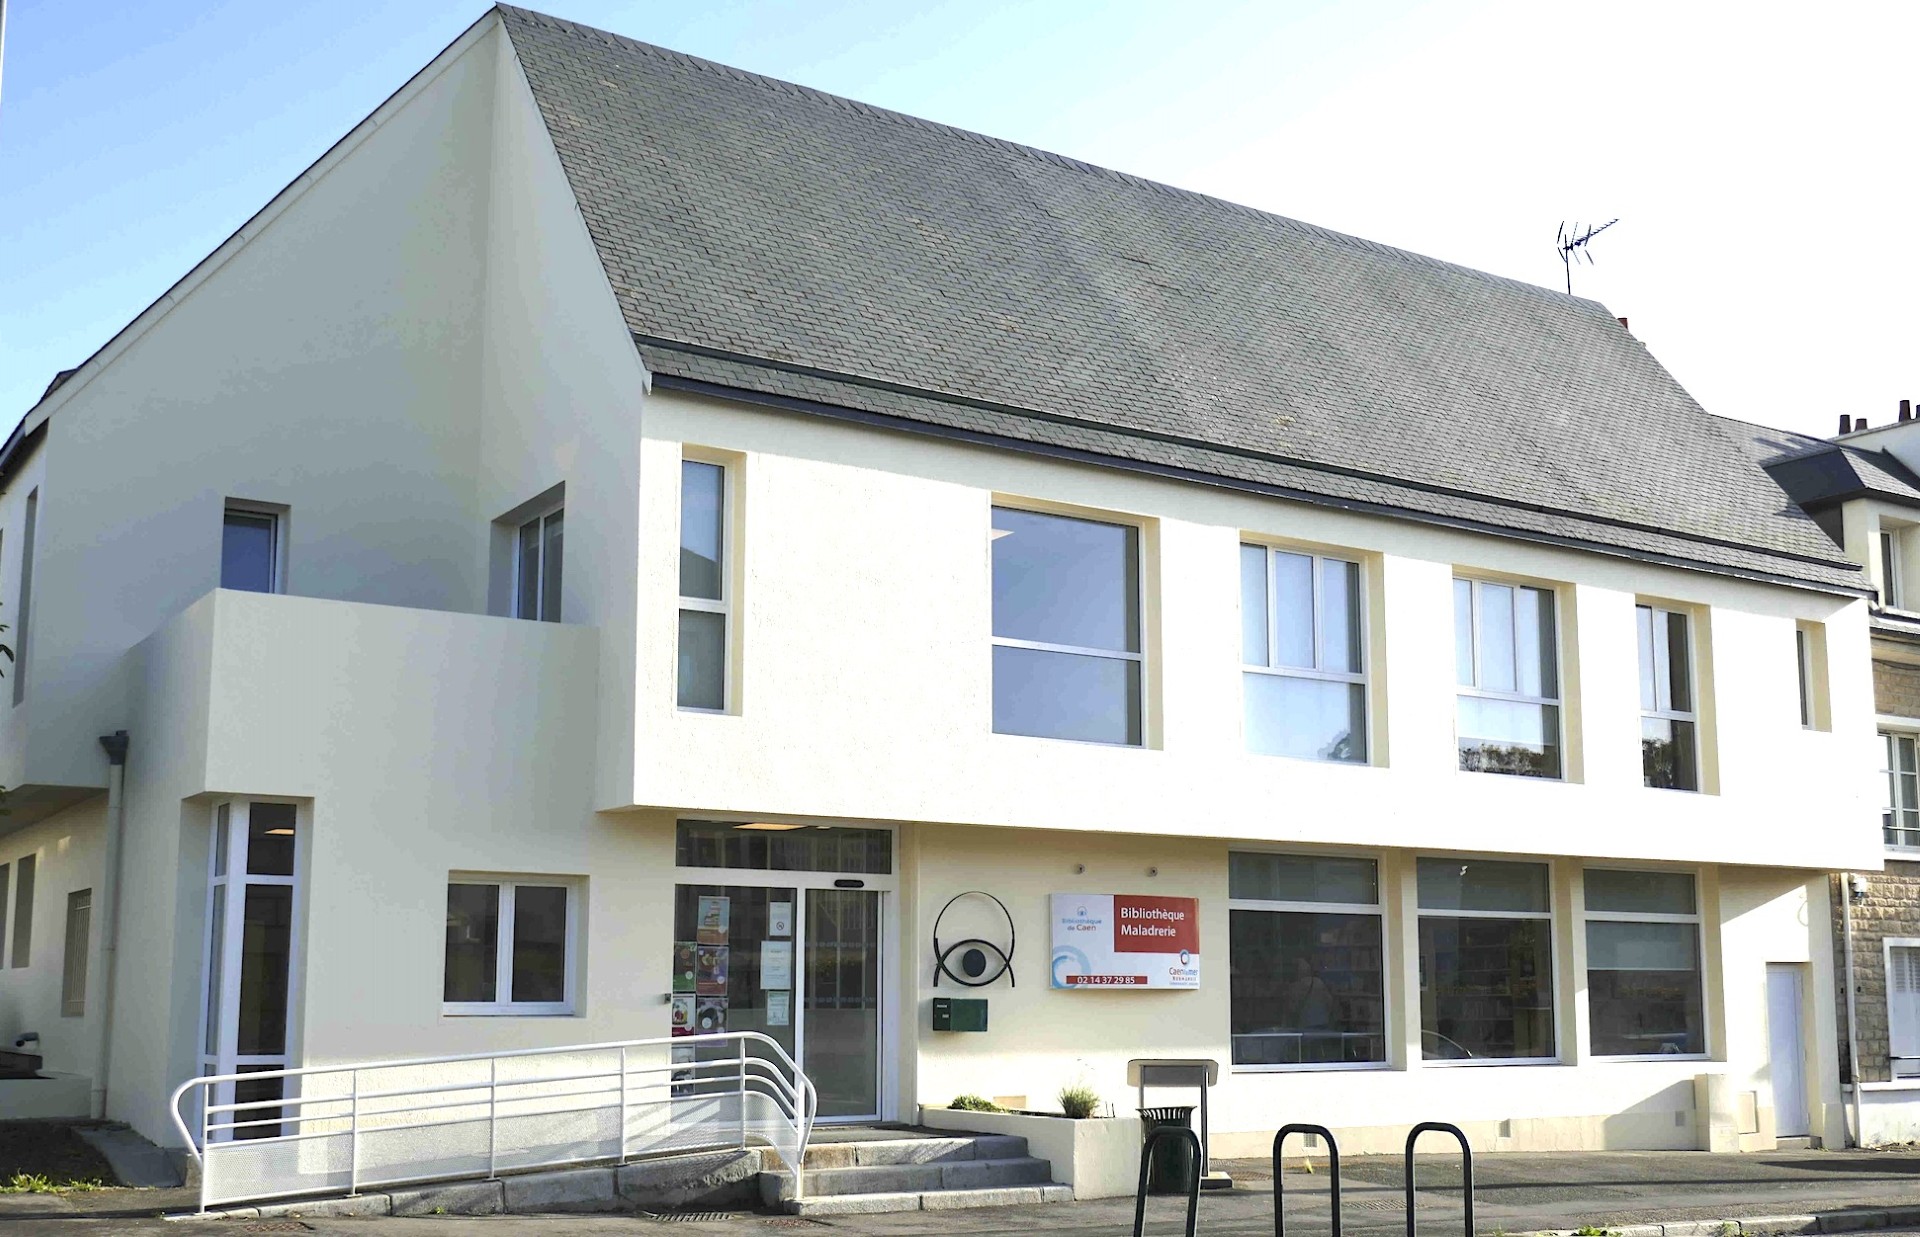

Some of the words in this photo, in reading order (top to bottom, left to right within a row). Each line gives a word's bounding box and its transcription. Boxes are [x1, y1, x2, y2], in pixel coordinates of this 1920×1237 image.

[1120, 907, 1185, 922] Bibliothèque
[1121, 924, 1176, 937] Maladrerie
[1077, 976, 1088, 984] 02
[1090, 976, 1101, 984] 14
[1102, 976, 1112, 984] 37
[1113, 976, 1124, 984] 29
[1125, 976, 1135, 984] 85
